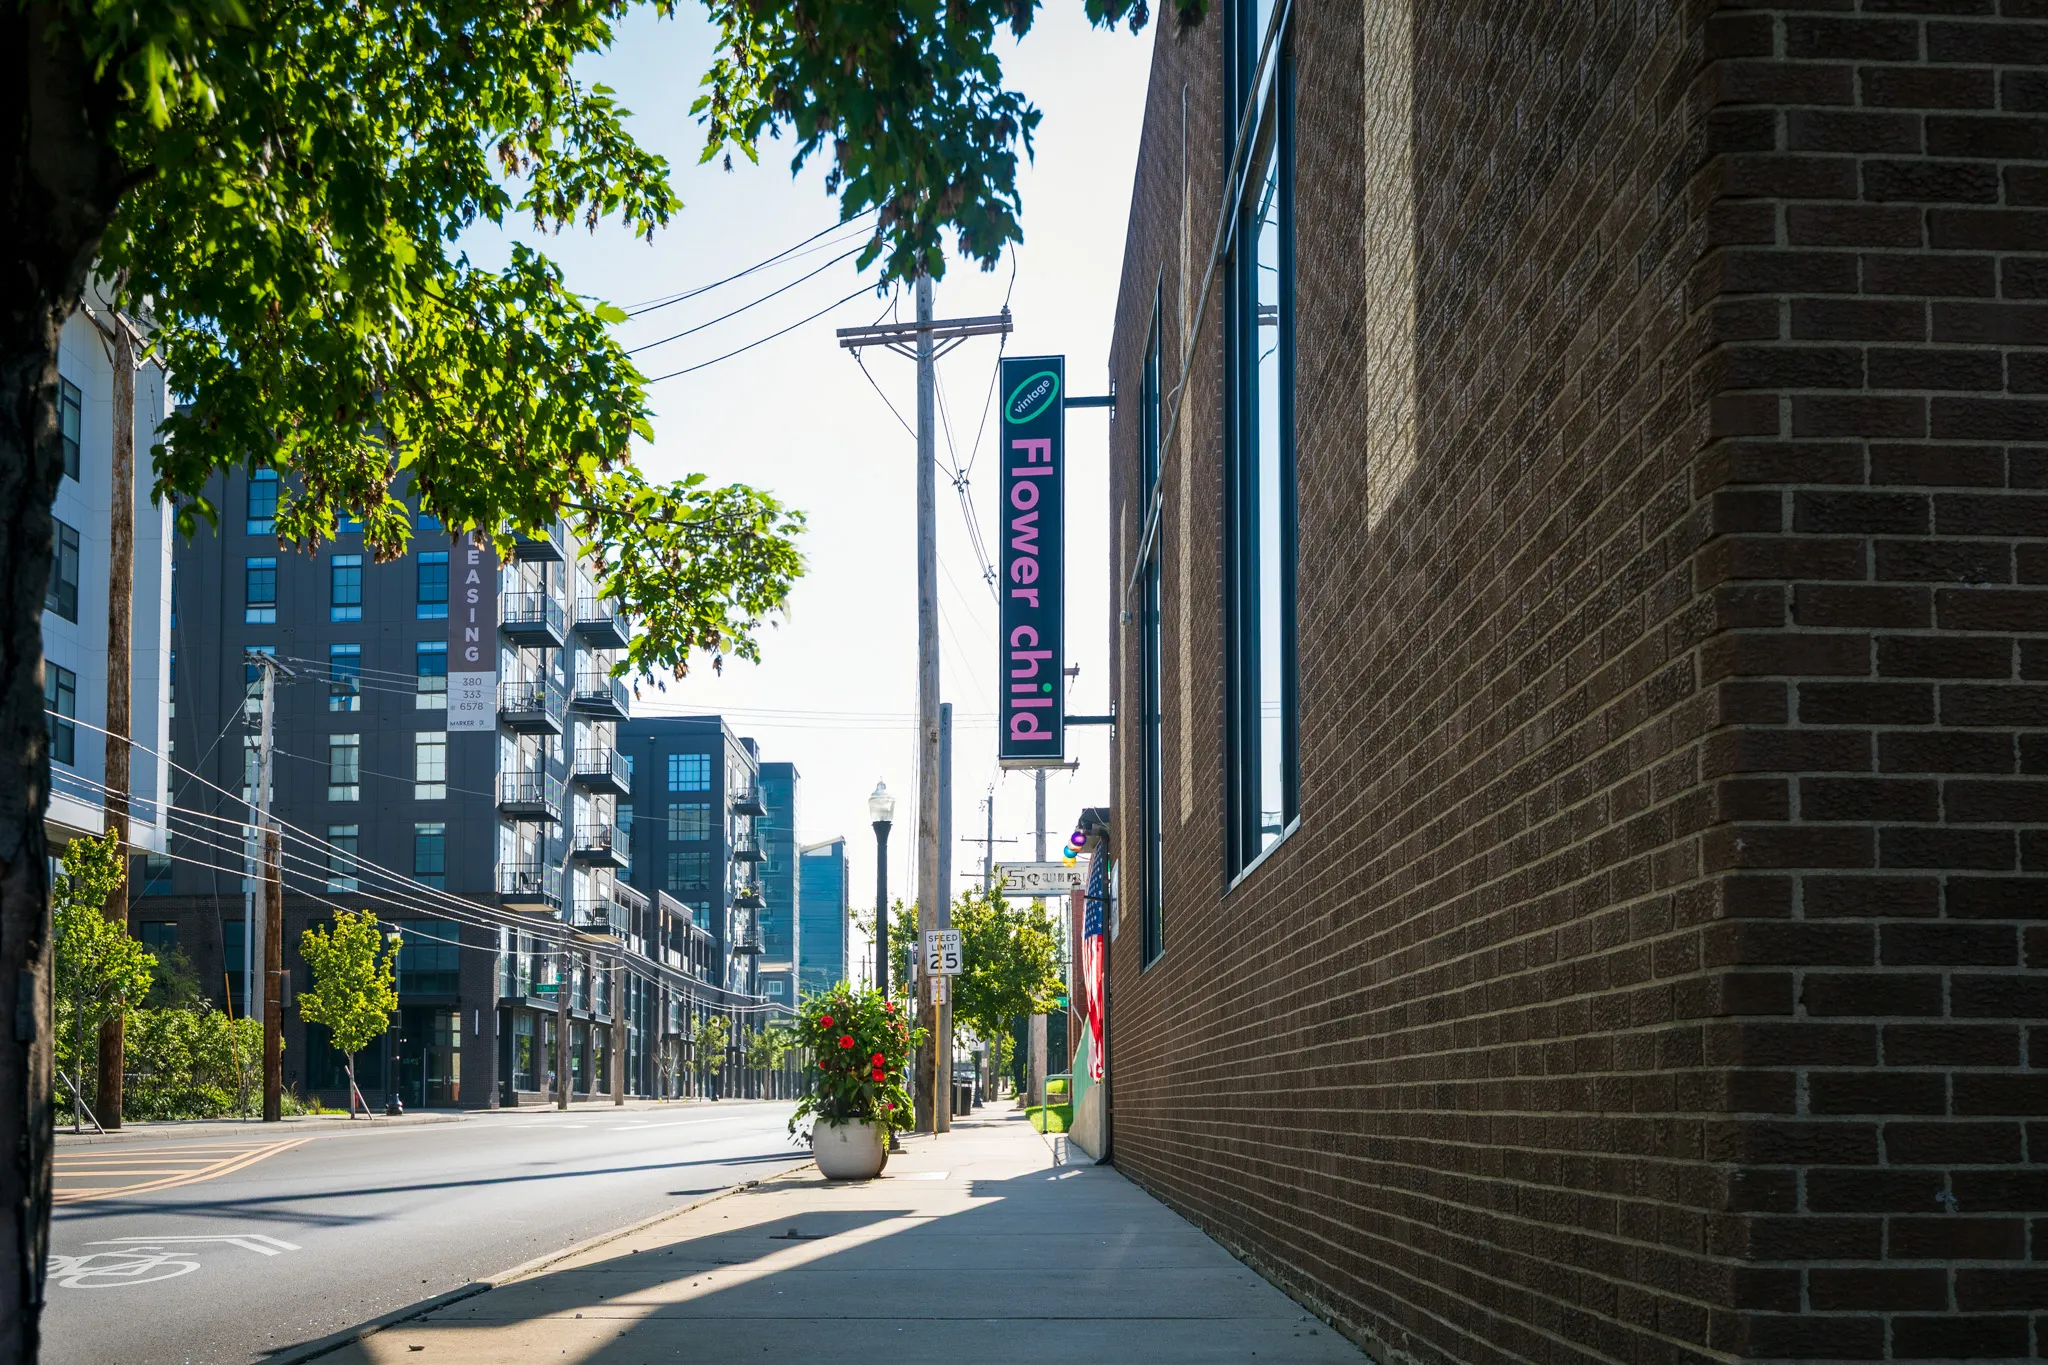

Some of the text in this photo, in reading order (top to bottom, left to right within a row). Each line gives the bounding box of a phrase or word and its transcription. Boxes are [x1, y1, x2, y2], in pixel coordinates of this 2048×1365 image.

[1014, 379, 1050, 414] vintage
[1011, 438, 1053, 741] Flower child
[465, 530, 481, 662] LEASING
[462, 677, 482, 686] 380
[463, 690, 482, 699] 333
[459, 702, 484, 711] 6578
[928, 934, 958, 942] SPEED
[932, 943, 955, 951] LIMIT
[929, 952, 958, 970] 25
